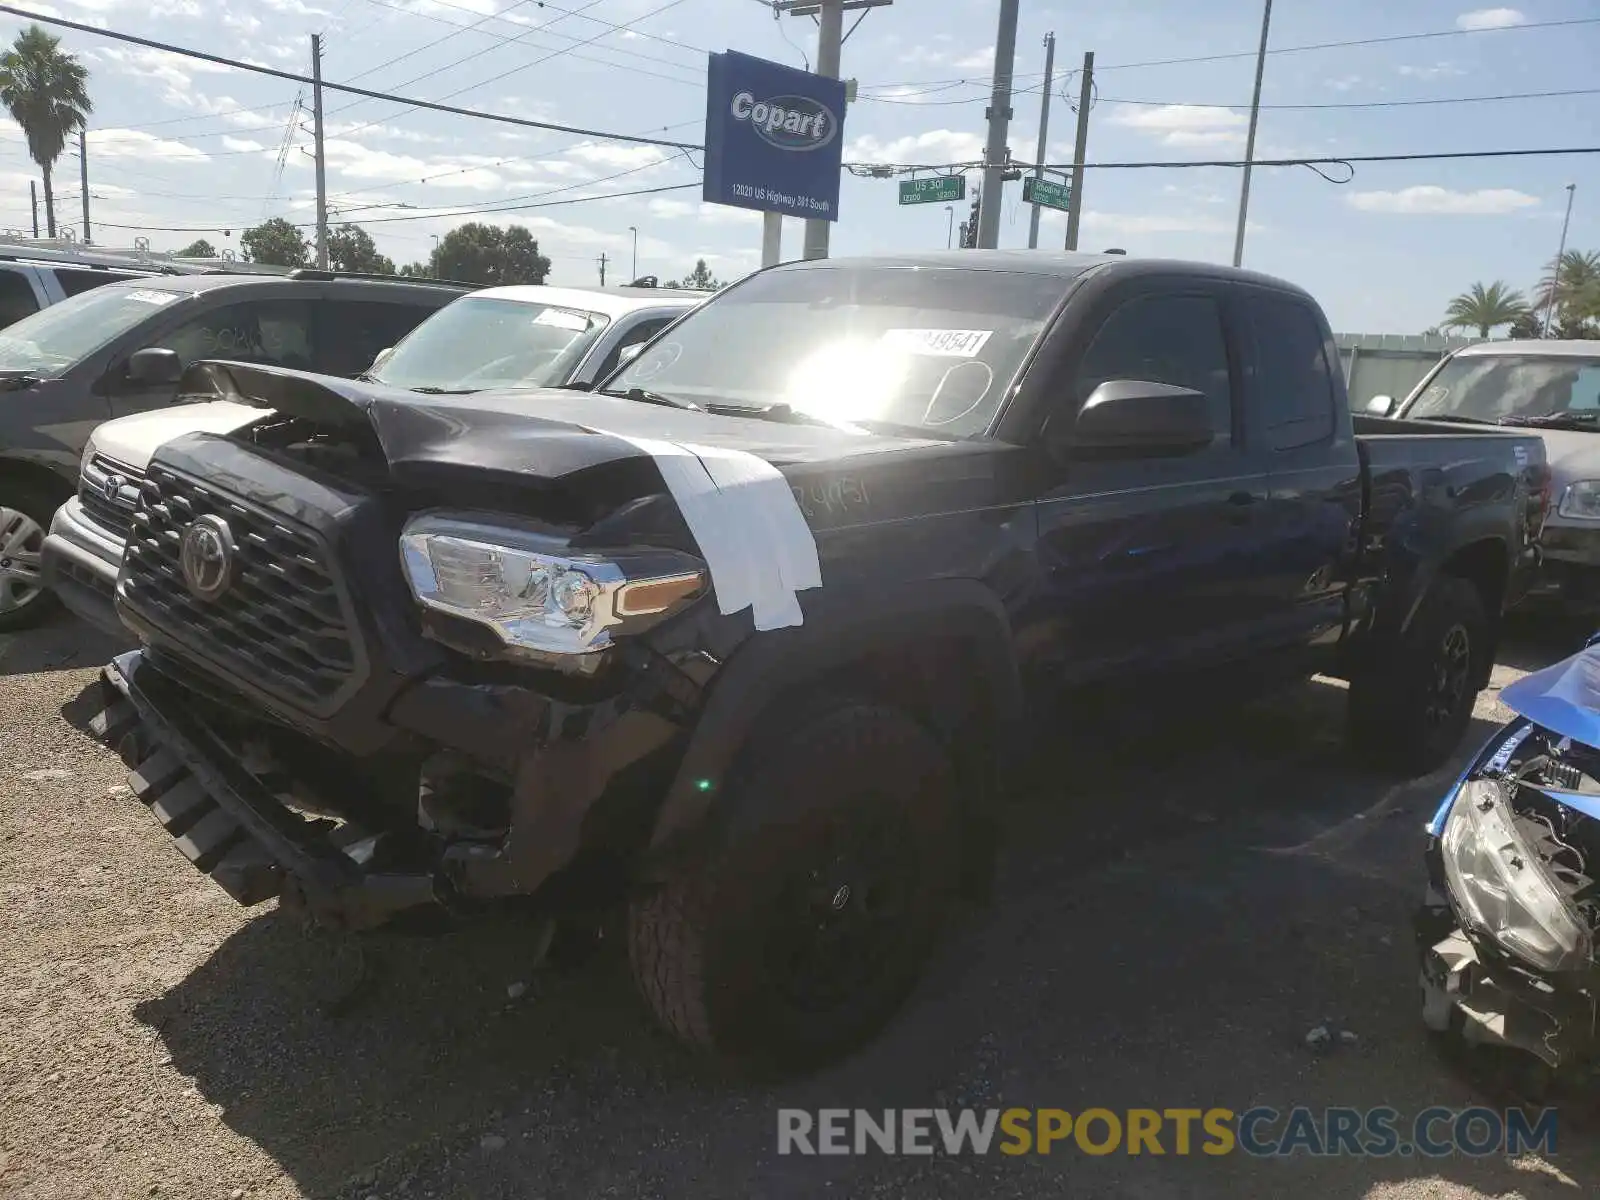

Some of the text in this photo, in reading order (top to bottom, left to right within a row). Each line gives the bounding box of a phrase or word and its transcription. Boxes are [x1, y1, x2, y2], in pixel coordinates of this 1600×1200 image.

[732, 91, 826, 139] Copart
[732, 183, 753, 197] 12020
[754, 187, 766, 199] US
[766, 190, 796, 208] Highway
[810, 198, 830, 212] South
[915, 179, 944, 191] US 301
